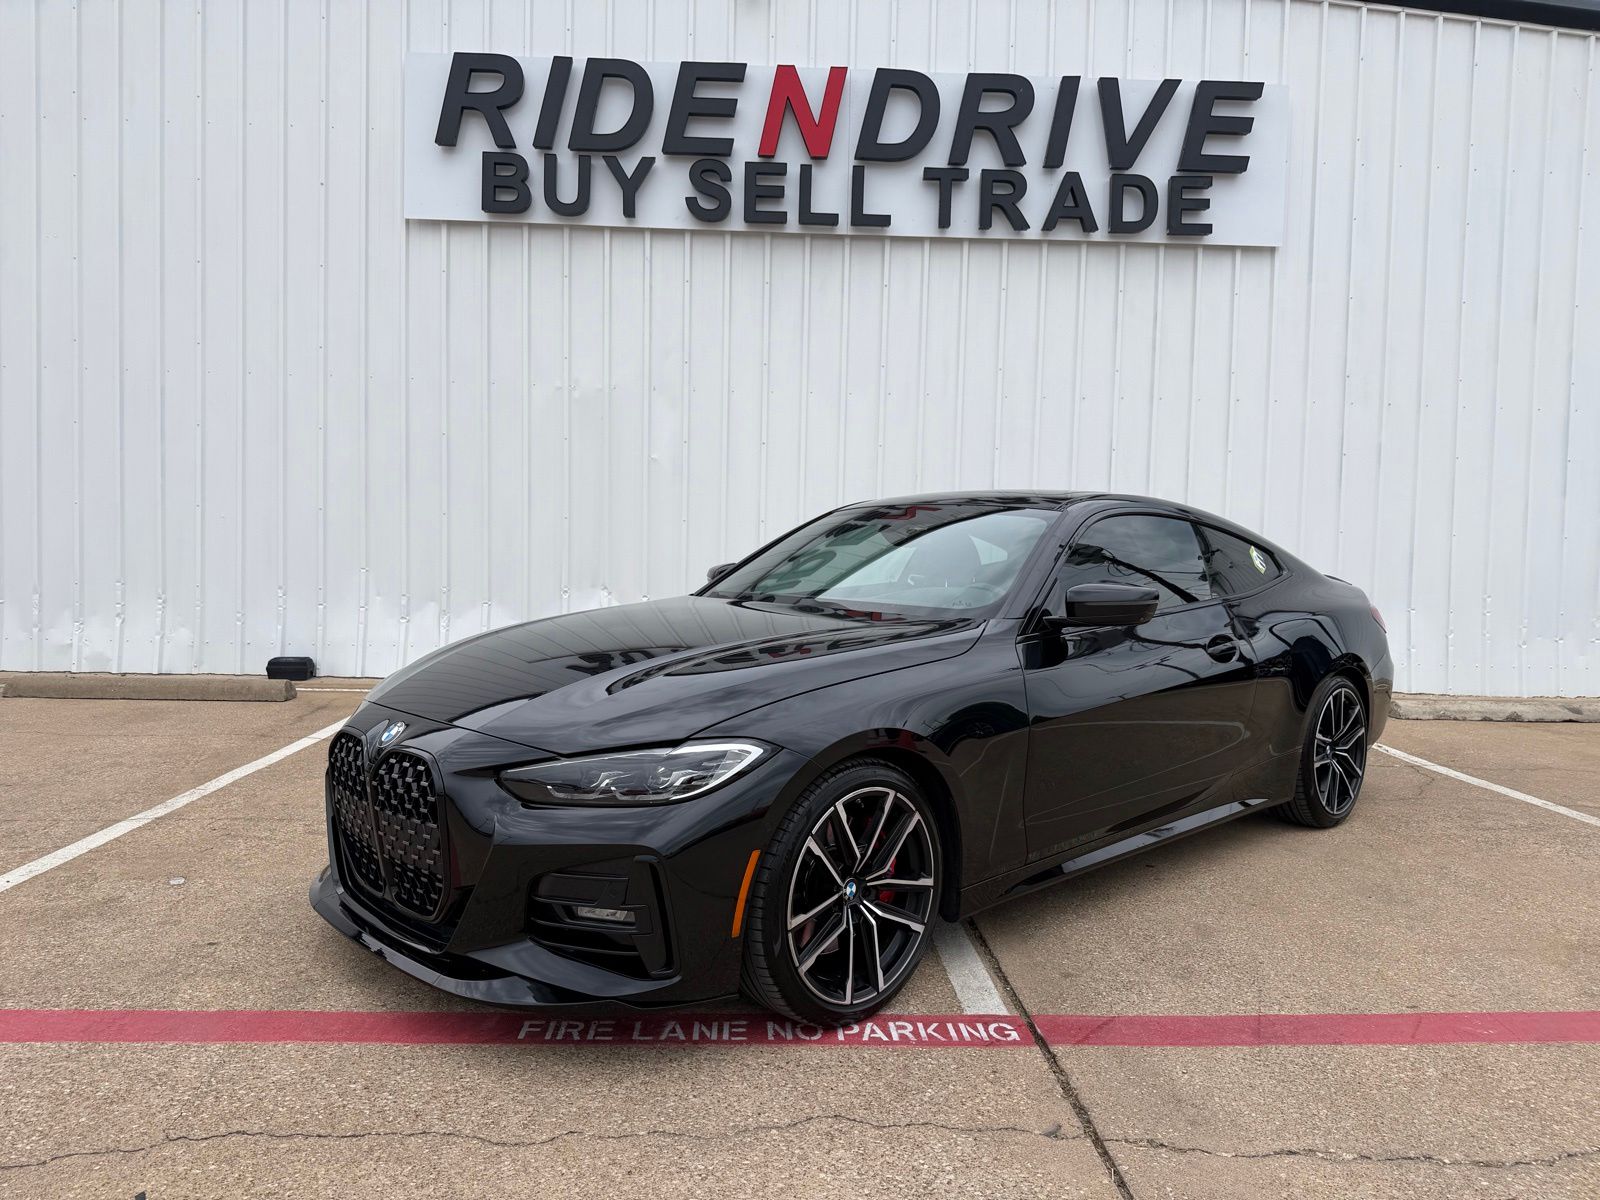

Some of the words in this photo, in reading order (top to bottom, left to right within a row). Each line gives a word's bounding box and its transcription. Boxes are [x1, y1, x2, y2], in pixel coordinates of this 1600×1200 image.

[481, 151, 656, 219] BUY
[685, 159, 892, 228] SELL
[923, 168, 1213, 236] TRADE
[517, 1020, 614, 1041] FIRE
[633, 1020, 747, 1041] LANE
[767, 1021, 823, 1041] NO
[837, 1021, 1021, 1042] PARKING
